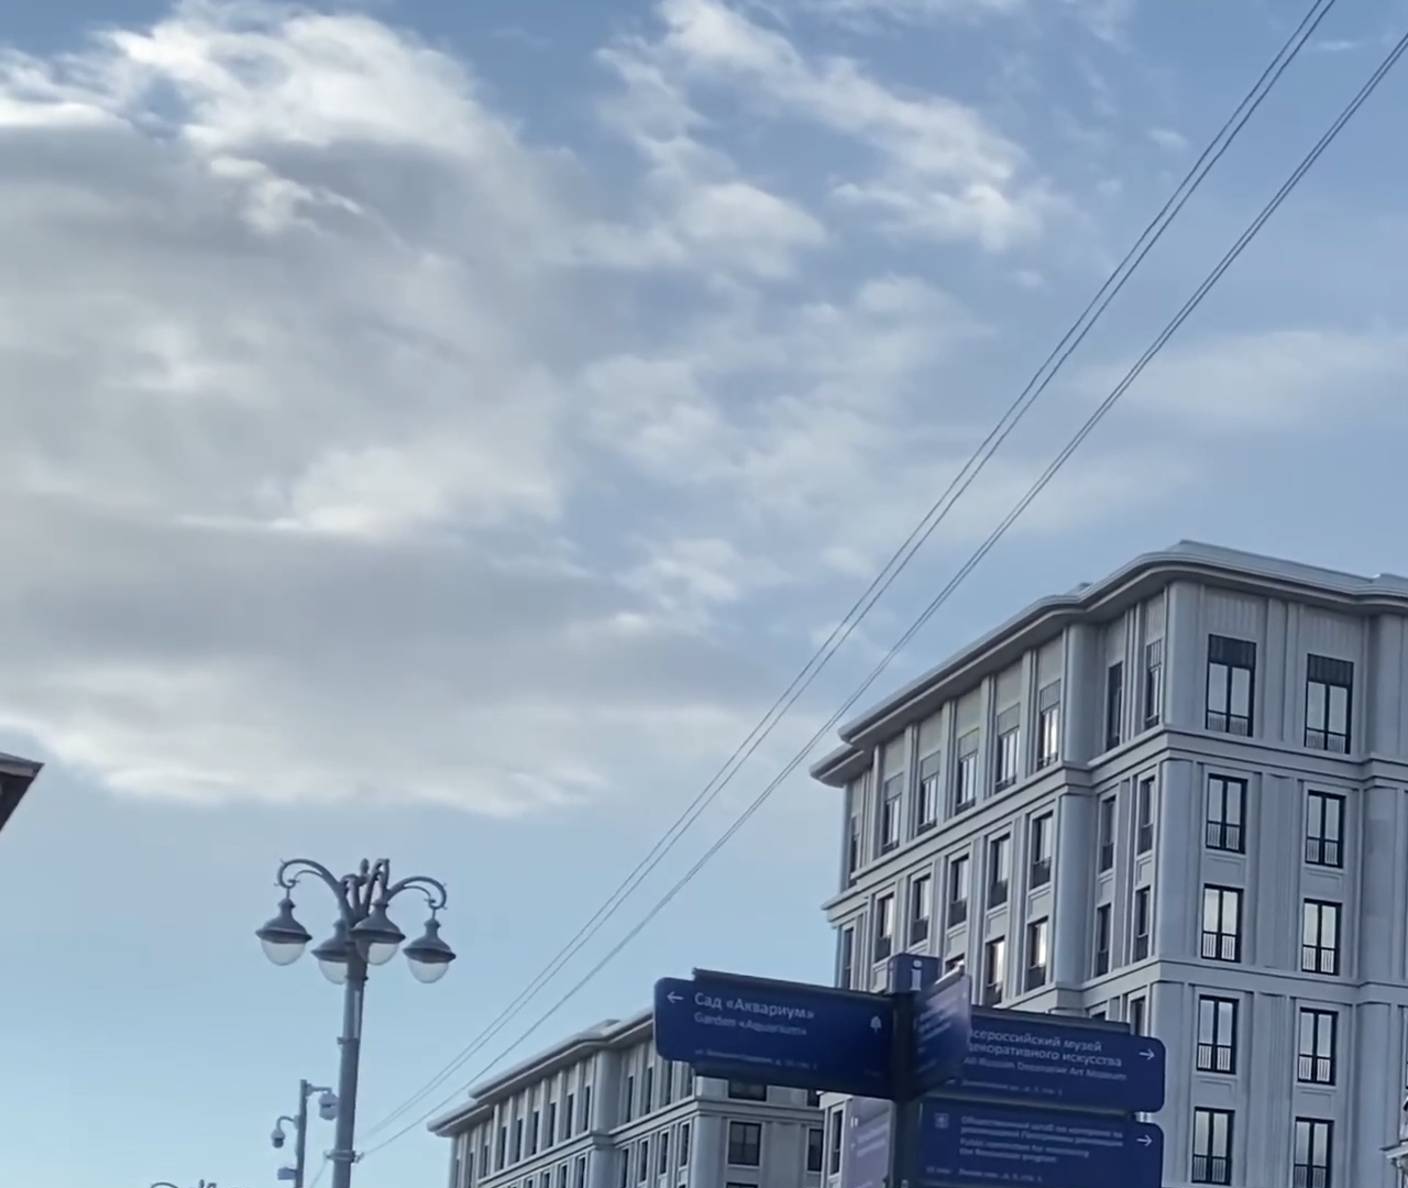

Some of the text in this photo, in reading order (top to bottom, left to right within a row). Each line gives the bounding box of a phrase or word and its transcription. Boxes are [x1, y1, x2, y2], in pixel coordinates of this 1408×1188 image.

[694, 991, 815, 1020] Сад «Аквариум»
[1063, 1039, 1102, 1052] музей
